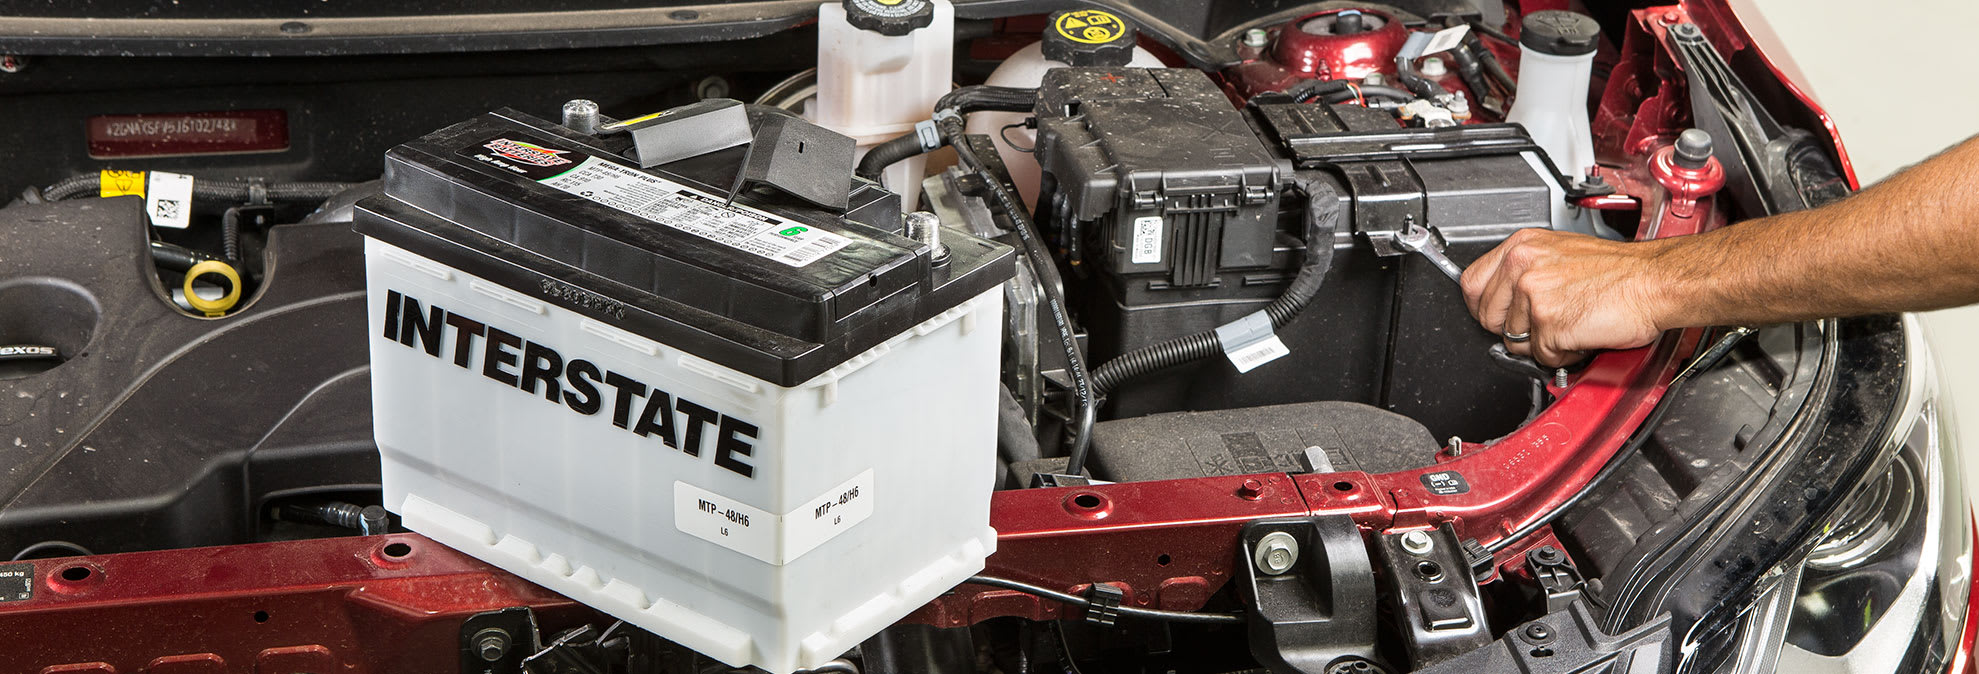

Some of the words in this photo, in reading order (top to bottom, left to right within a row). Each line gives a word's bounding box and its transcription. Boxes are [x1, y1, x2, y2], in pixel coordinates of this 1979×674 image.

[779, 226, 808, 237] 6
[0, 346, 56, 355] exos
[383, 288, 760, 479] INTERSTATE
[833, 515, 841, 526] L6
[720, 526, 729, 537] L6
